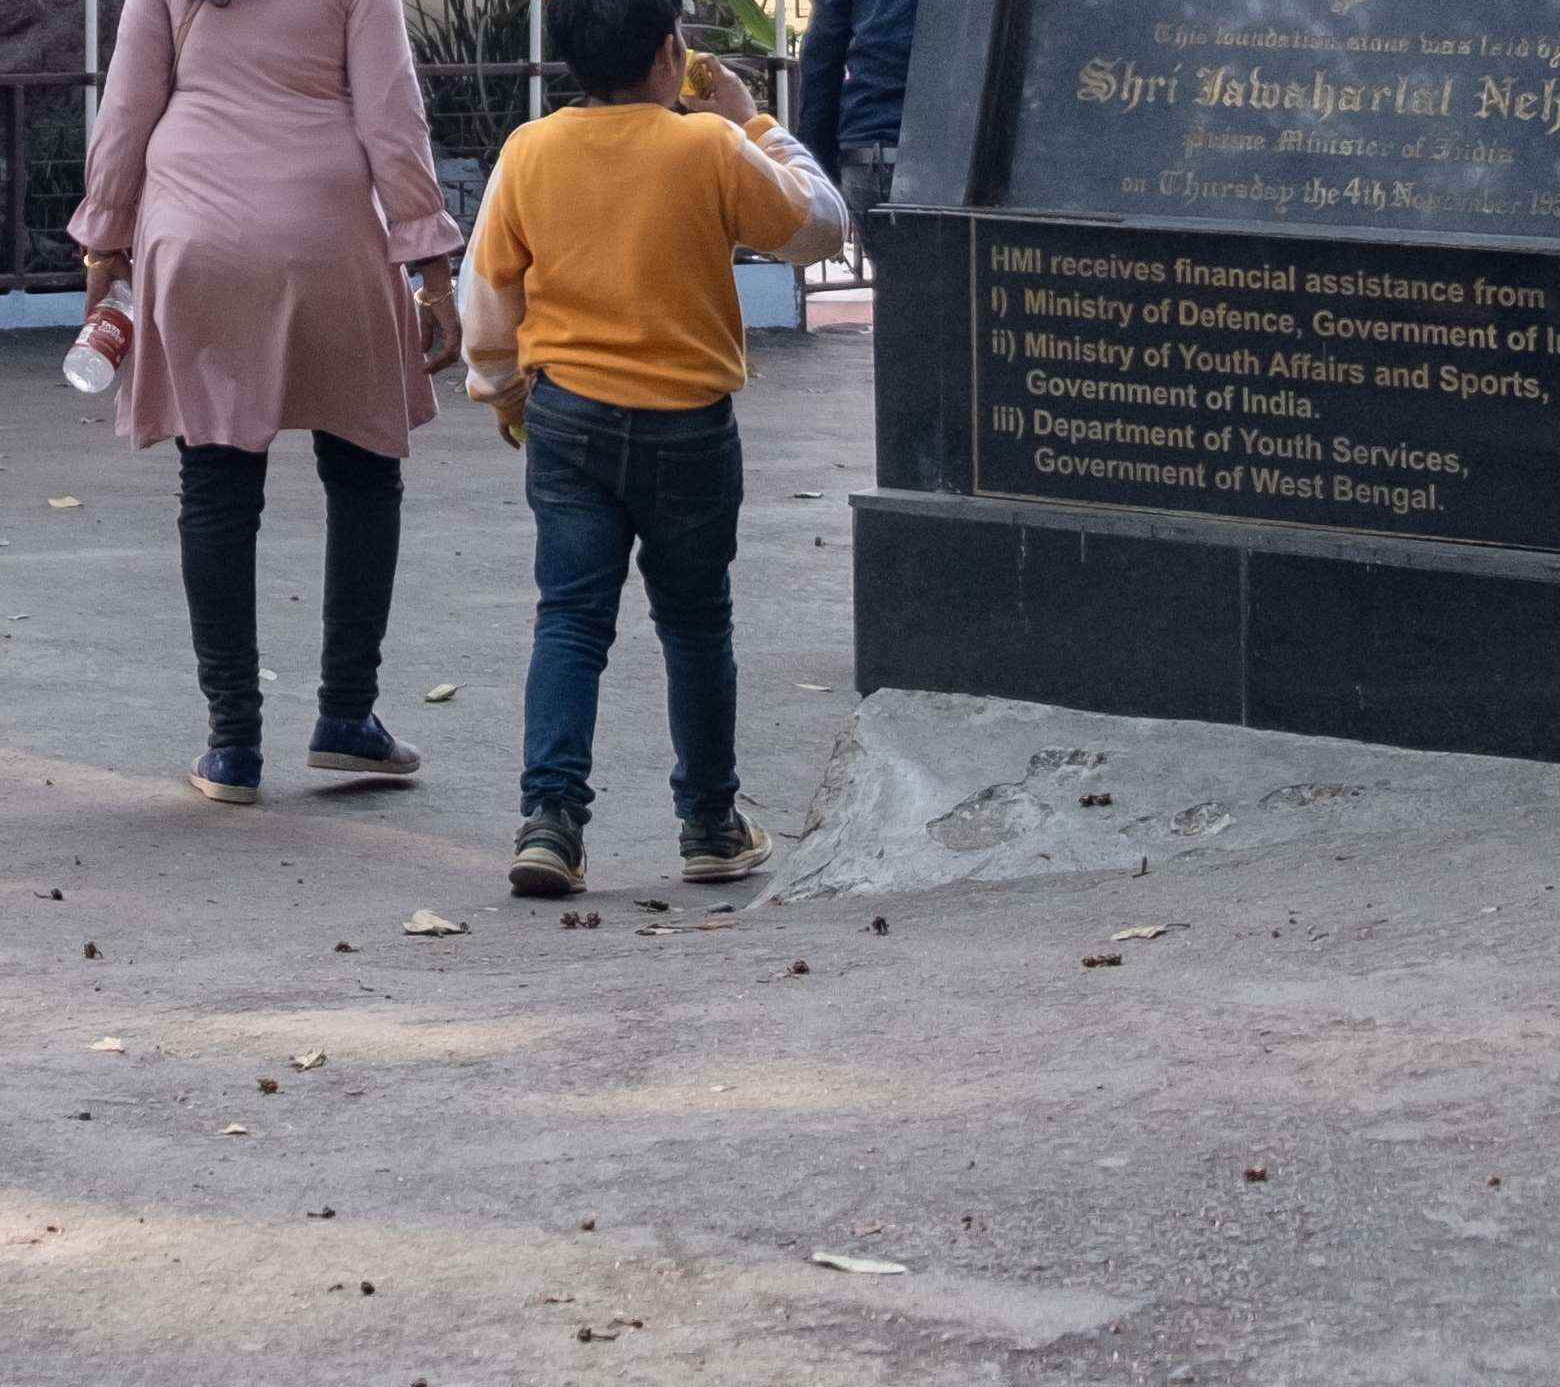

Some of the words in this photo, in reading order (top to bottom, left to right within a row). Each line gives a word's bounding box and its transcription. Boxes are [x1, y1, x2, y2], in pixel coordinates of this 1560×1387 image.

[1193, 64, 1454, 123] Jawaharlal
[1400, 135, 1426, 159] of
[1303, 177, 1340, 211] the
[991, 244, 1043, 275] HMI
[1050, 254, 1166, 283] receives
[1174, 257, 1296, 292] financial
[1305, 271, 1464, 303] assistance
[1472, 277, 1546, 309] from
[1024, 288, 1133, 328] Ministry
[1142, 299, 1171, 325] of
[1179, 300, 1304, 339] Defence,
[1312, 310, 1498, 349] Government
[1506, 325, 1539, 352] of
[991, 329, 1017, 363] ii)
[1024, 330, 1135, 372] Ministry
[1143, 342, 1171, 368] of
[1179, 343, 1260, 376] Youth
[1268, 352, 1365, 385] Affairs
[1375, 363, 1429, 390] and
[1440, 365, 1550, 405] Sports,
[1026, 369, 1198, 409] Government
[1206, 385, 1235, 411] of
[1243, 386, 1320, 420] India.
[1033, 408, 1195, 450] Department
[1204, 426, 1233, 452] of
[1240, 428, 1322, 461] Youth
[1331, 436, 1469, 479] Services,
[1034, 447, 1207, 489] Government
[1214, 465, 1245, 491] of
[1251, 466, 1324, 499] West
[1333, 475, 1445, 515] Bengal.
